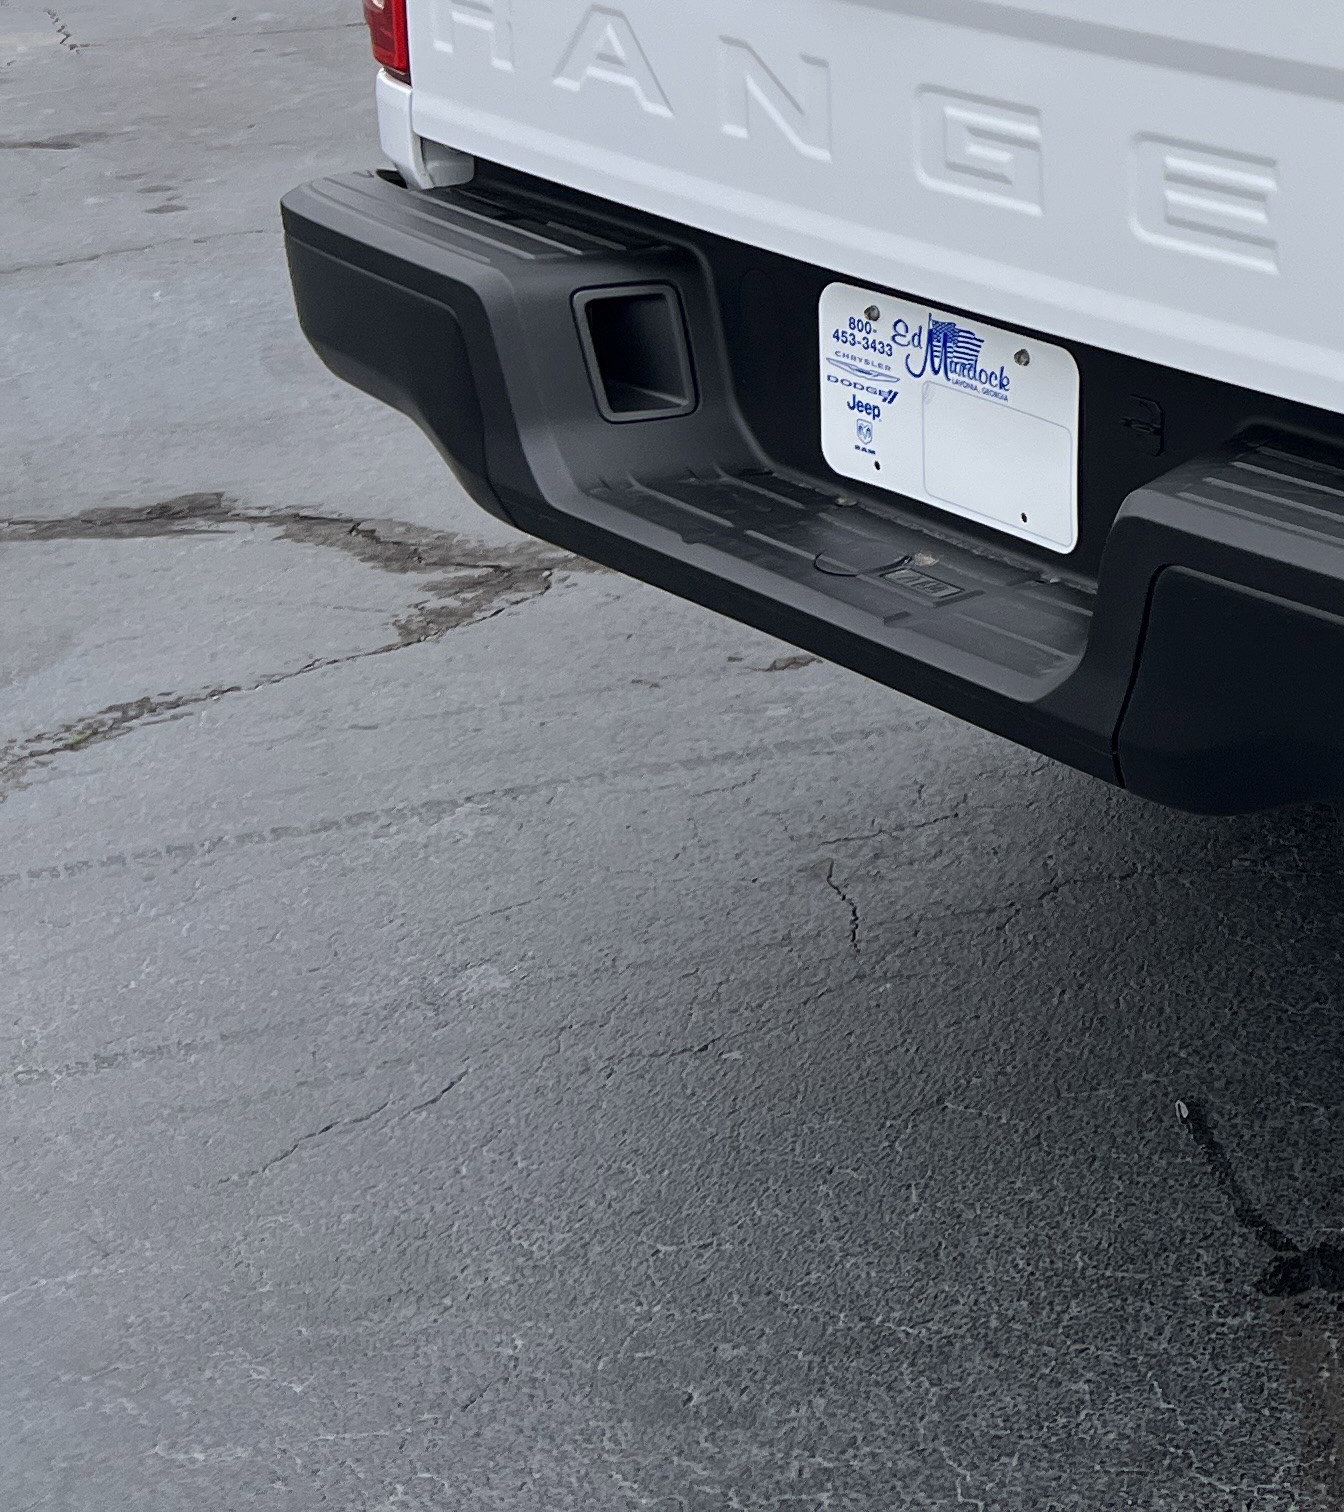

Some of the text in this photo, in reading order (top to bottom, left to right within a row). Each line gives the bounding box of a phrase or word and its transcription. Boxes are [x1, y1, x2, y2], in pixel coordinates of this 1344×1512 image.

[832, 328, 893, 357] 453-3433
[891, 318, 923, 350] Ed
[834, 350, 892, 371] CHRYSLER
[905, 314, 1010, 392] Murdock
[846, 393, 881, 420] Jeep
[854, 444, 876, 455] RAM
